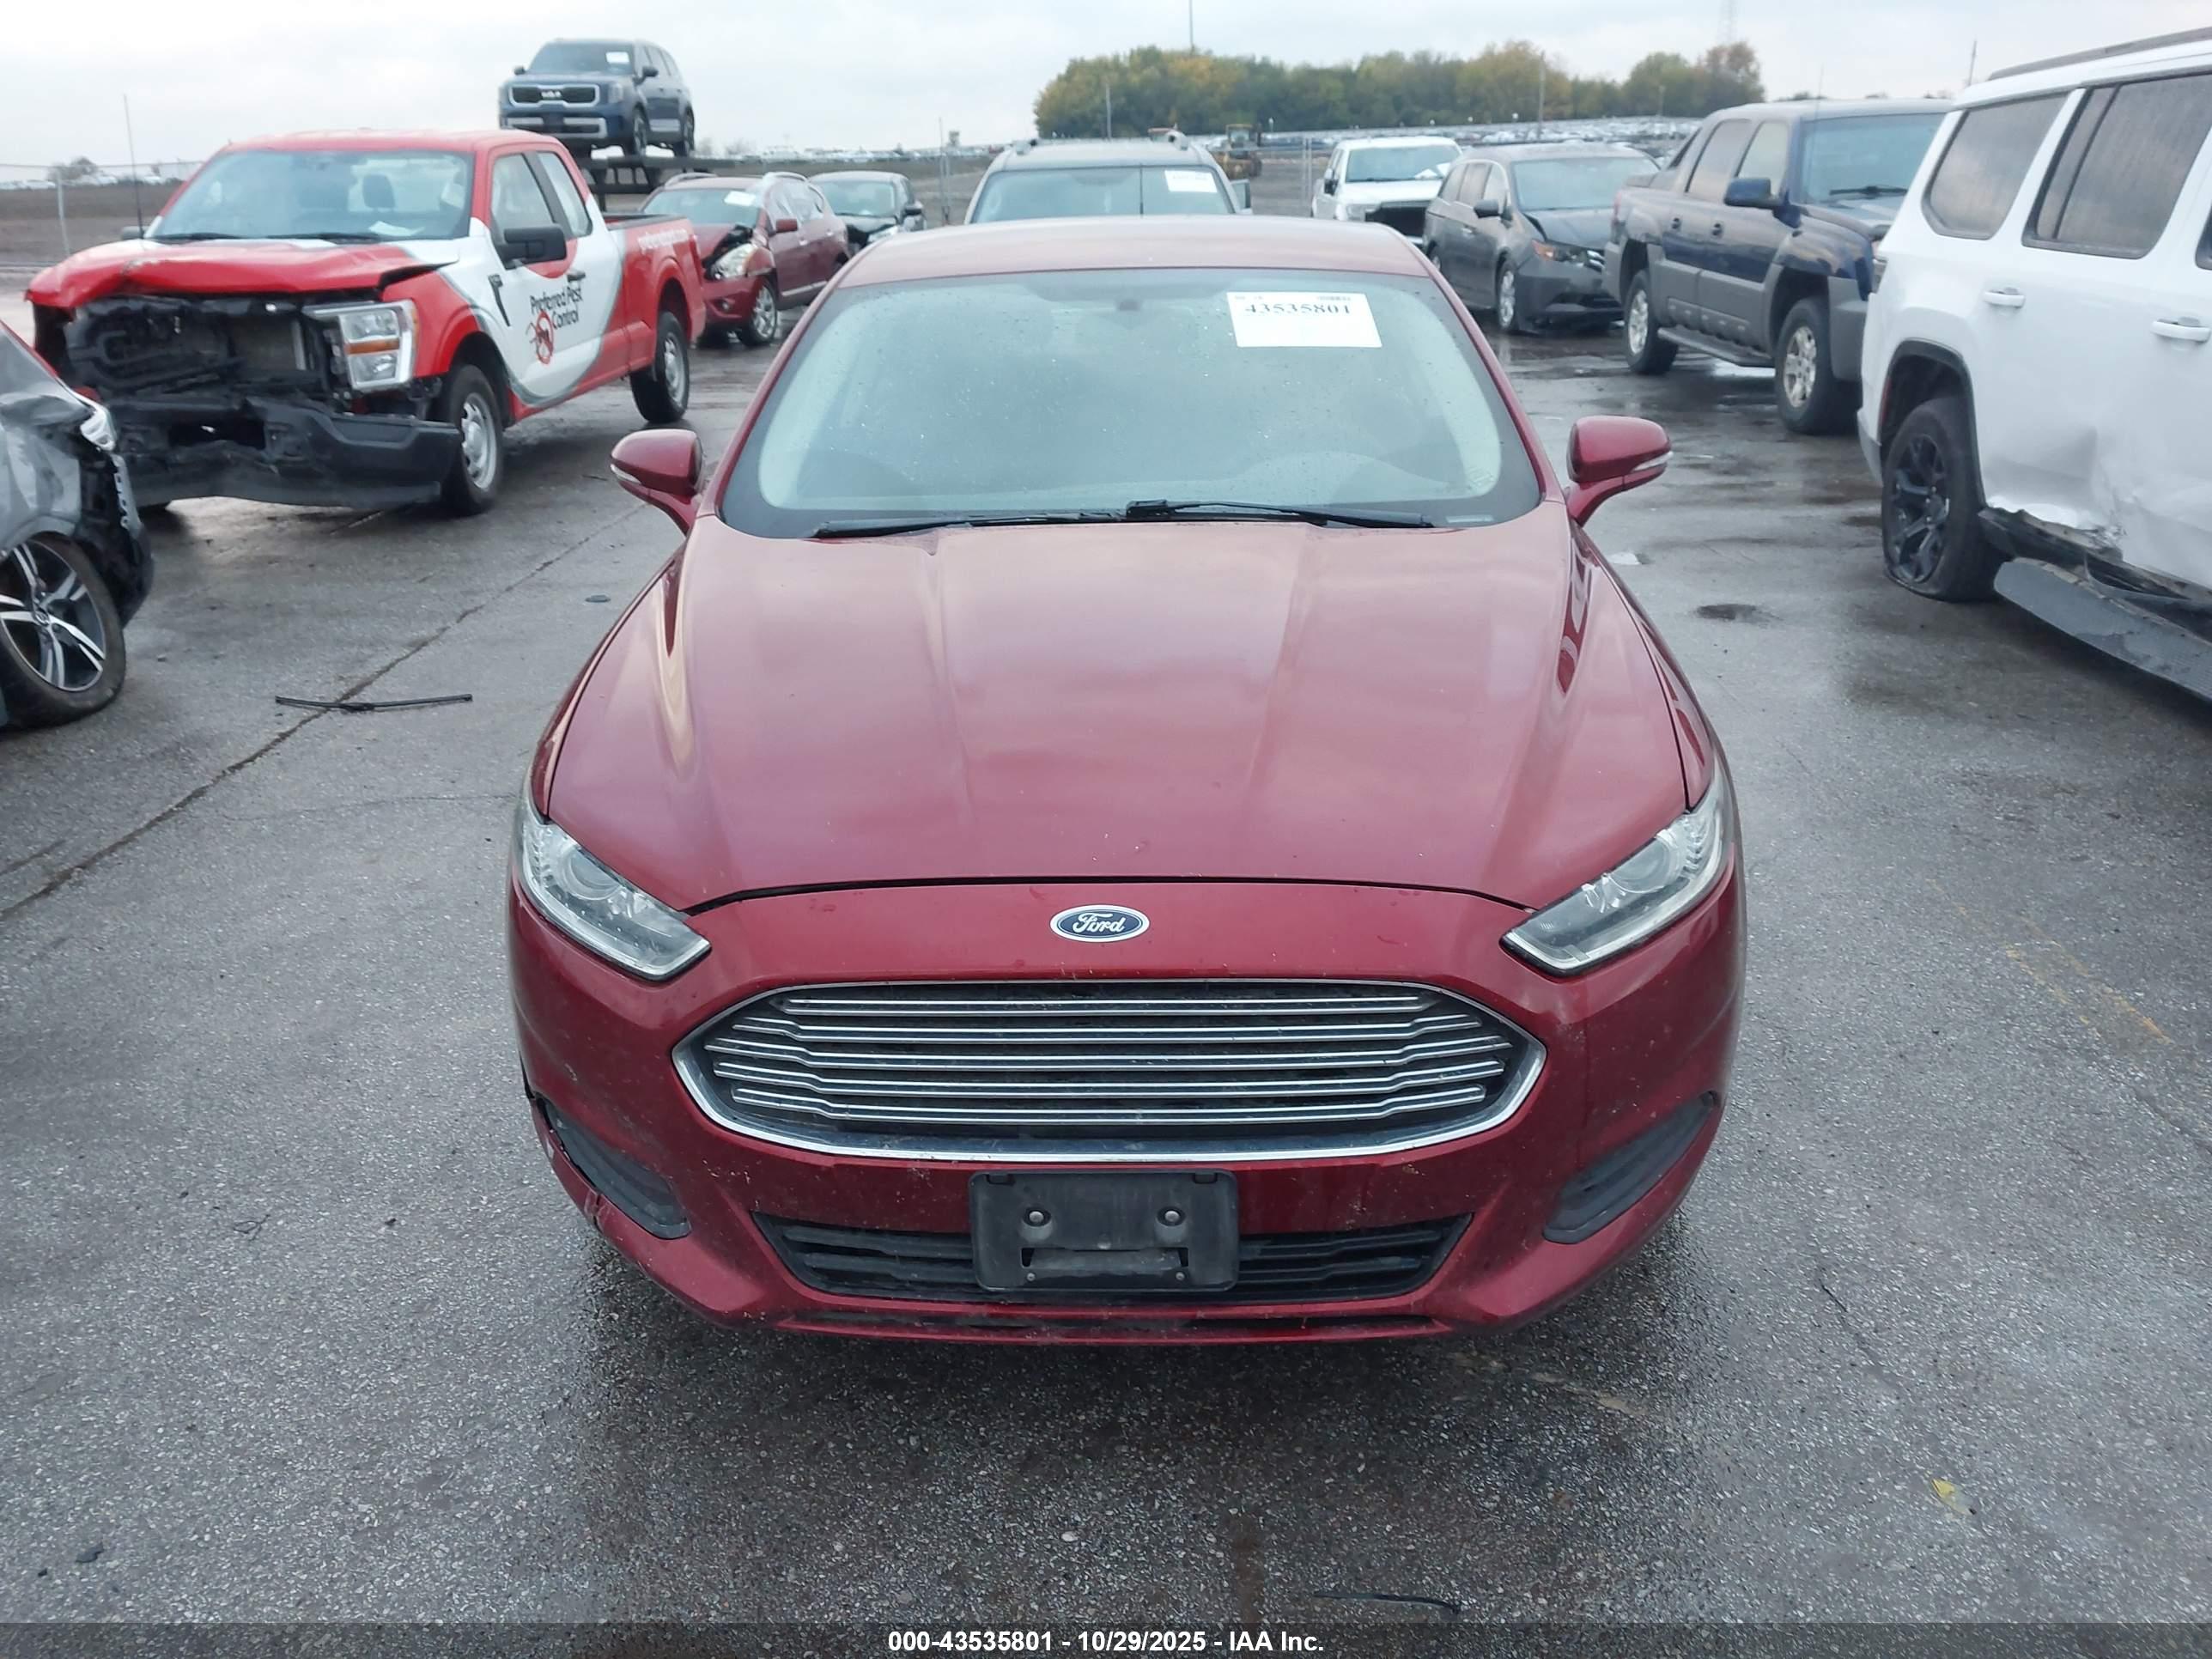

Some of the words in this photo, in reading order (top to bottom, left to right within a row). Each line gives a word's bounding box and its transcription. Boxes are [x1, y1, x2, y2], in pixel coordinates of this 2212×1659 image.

[530, 289, 566, 315] Preferred
[566, 284, 583, 305] Pest
[1244, 303, 1351, 314] 43535801
[551, 303, 579, 330] Control
[1073, 912, 1127, 933] Ford
